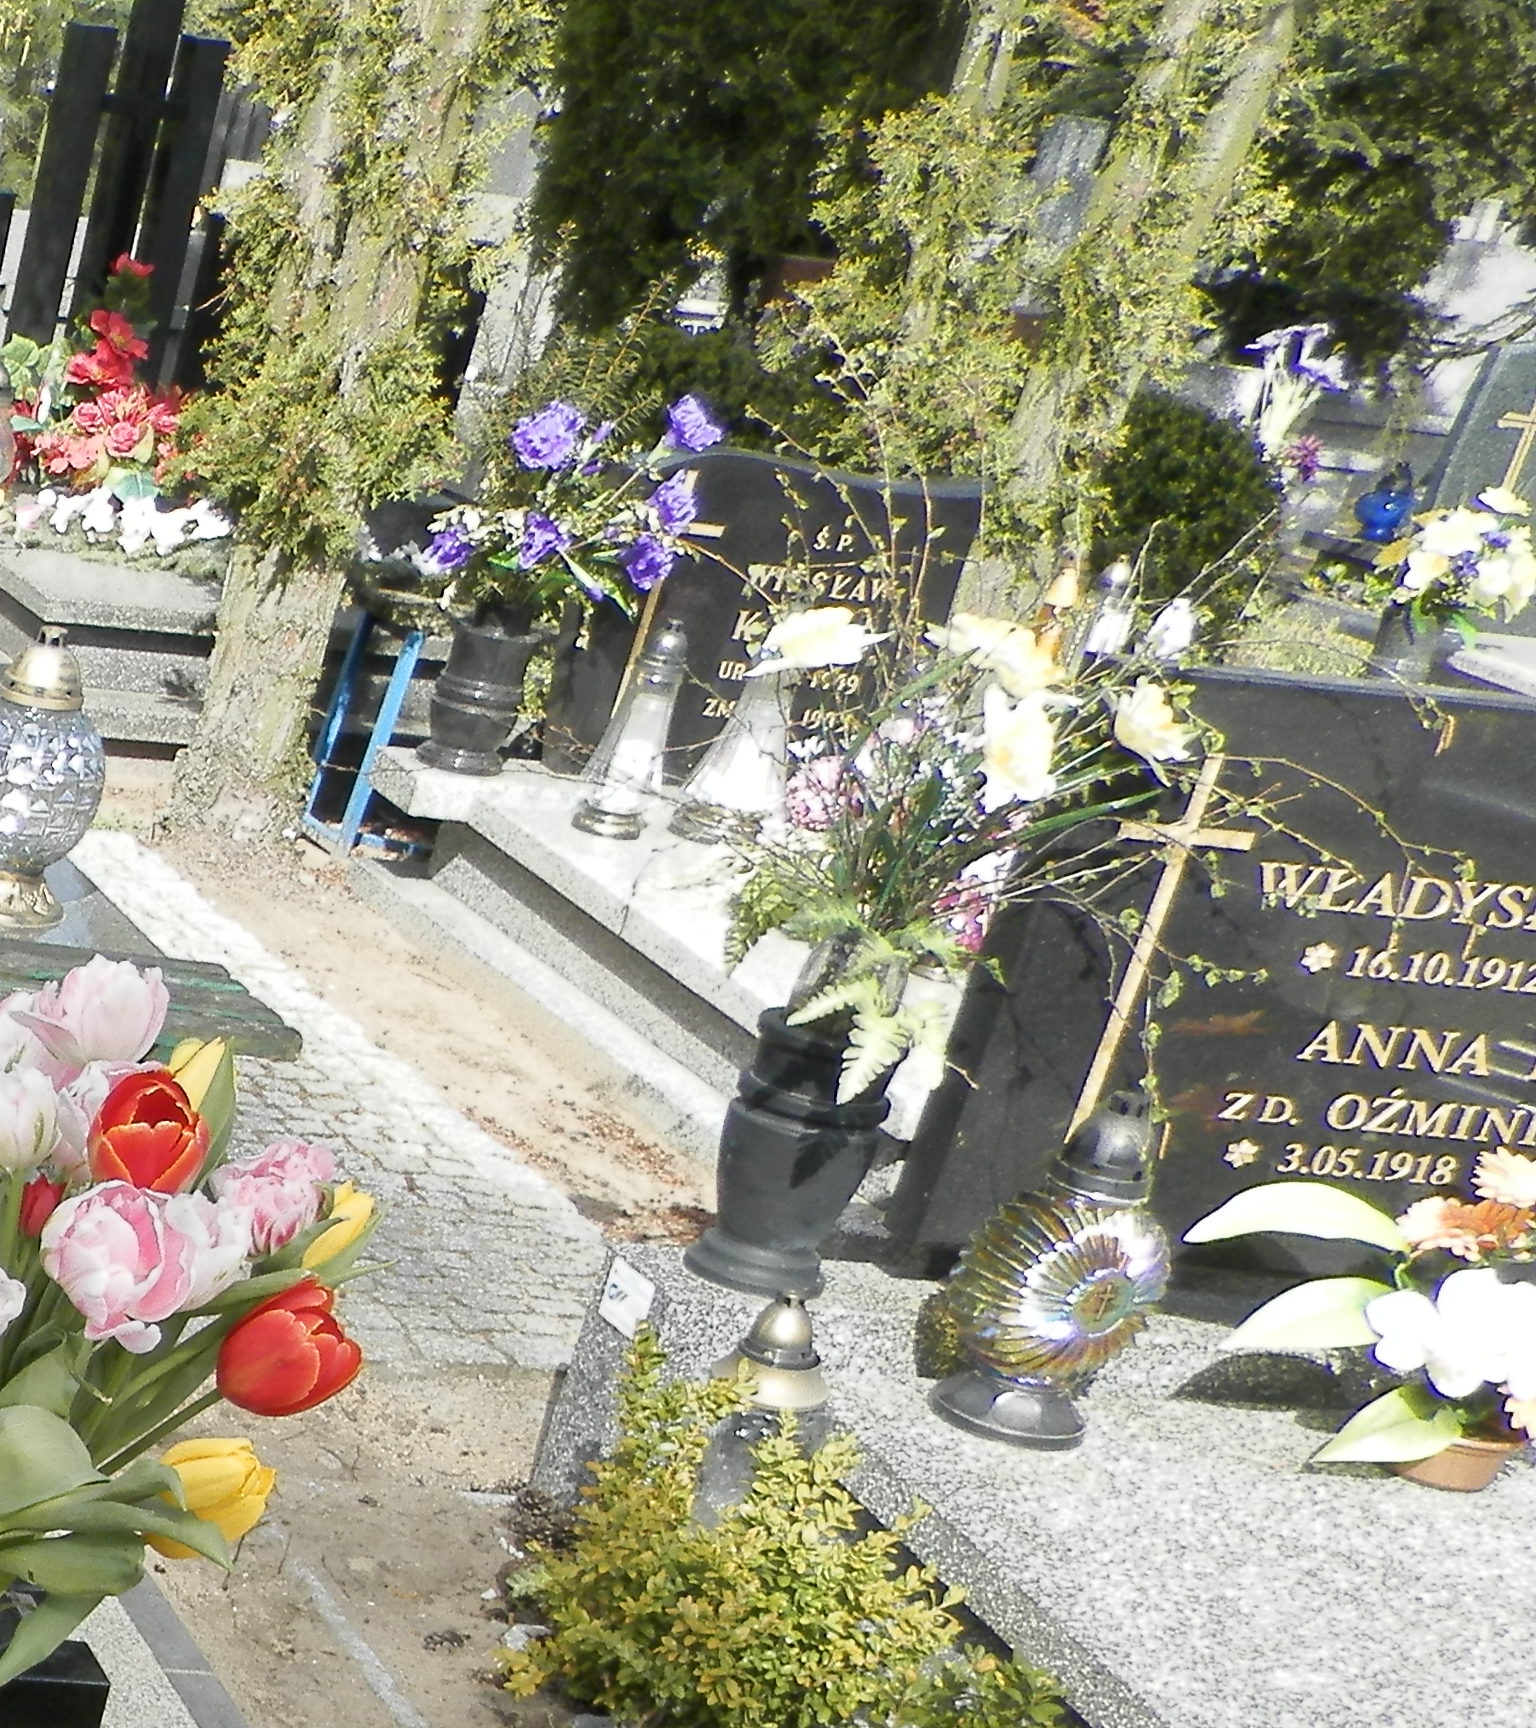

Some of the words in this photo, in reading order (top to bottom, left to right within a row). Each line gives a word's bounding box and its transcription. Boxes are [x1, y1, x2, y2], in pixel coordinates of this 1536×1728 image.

[1260, 861, 1536, 932] WŁADYS
[1296, 1019, 1491, 1077] ANNA
[1276, 1142, 1458, 1186] 3.05.1918
